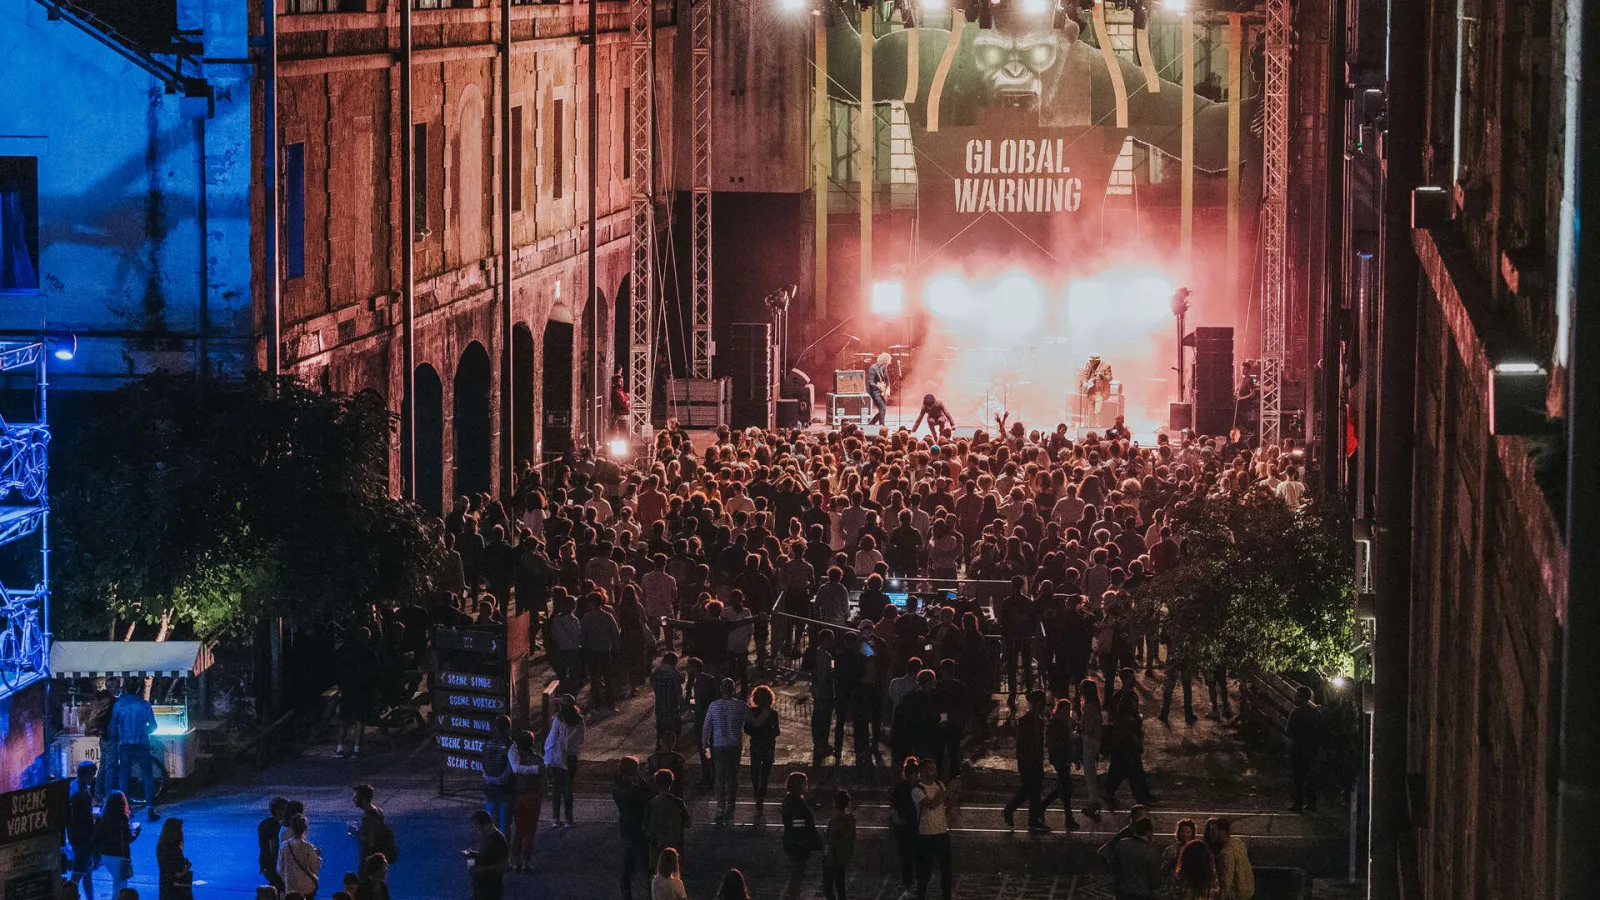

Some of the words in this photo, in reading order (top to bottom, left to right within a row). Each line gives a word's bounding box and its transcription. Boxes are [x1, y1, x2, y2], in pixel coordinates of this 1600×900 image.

[965, 139, 1071, 174] GLOBAL
[954, 177, 1082, 213] WARNING
[447, 673, 468, 686] SCENE
[449, 695, 470, 706] SCENE
[472, 696, 497, 709] VORTEX
[451, 716, 470, 728] SCENE
[473, 719, 491, 732] NOVA
[441, 736, 460, 749] SCENE
[463, 739, 485, 752] SKATE
[447, 755, 468, 769] SCENE
[11, 788, 48, 816] SCENE
[7, 809, 49, 837] VORTEX
